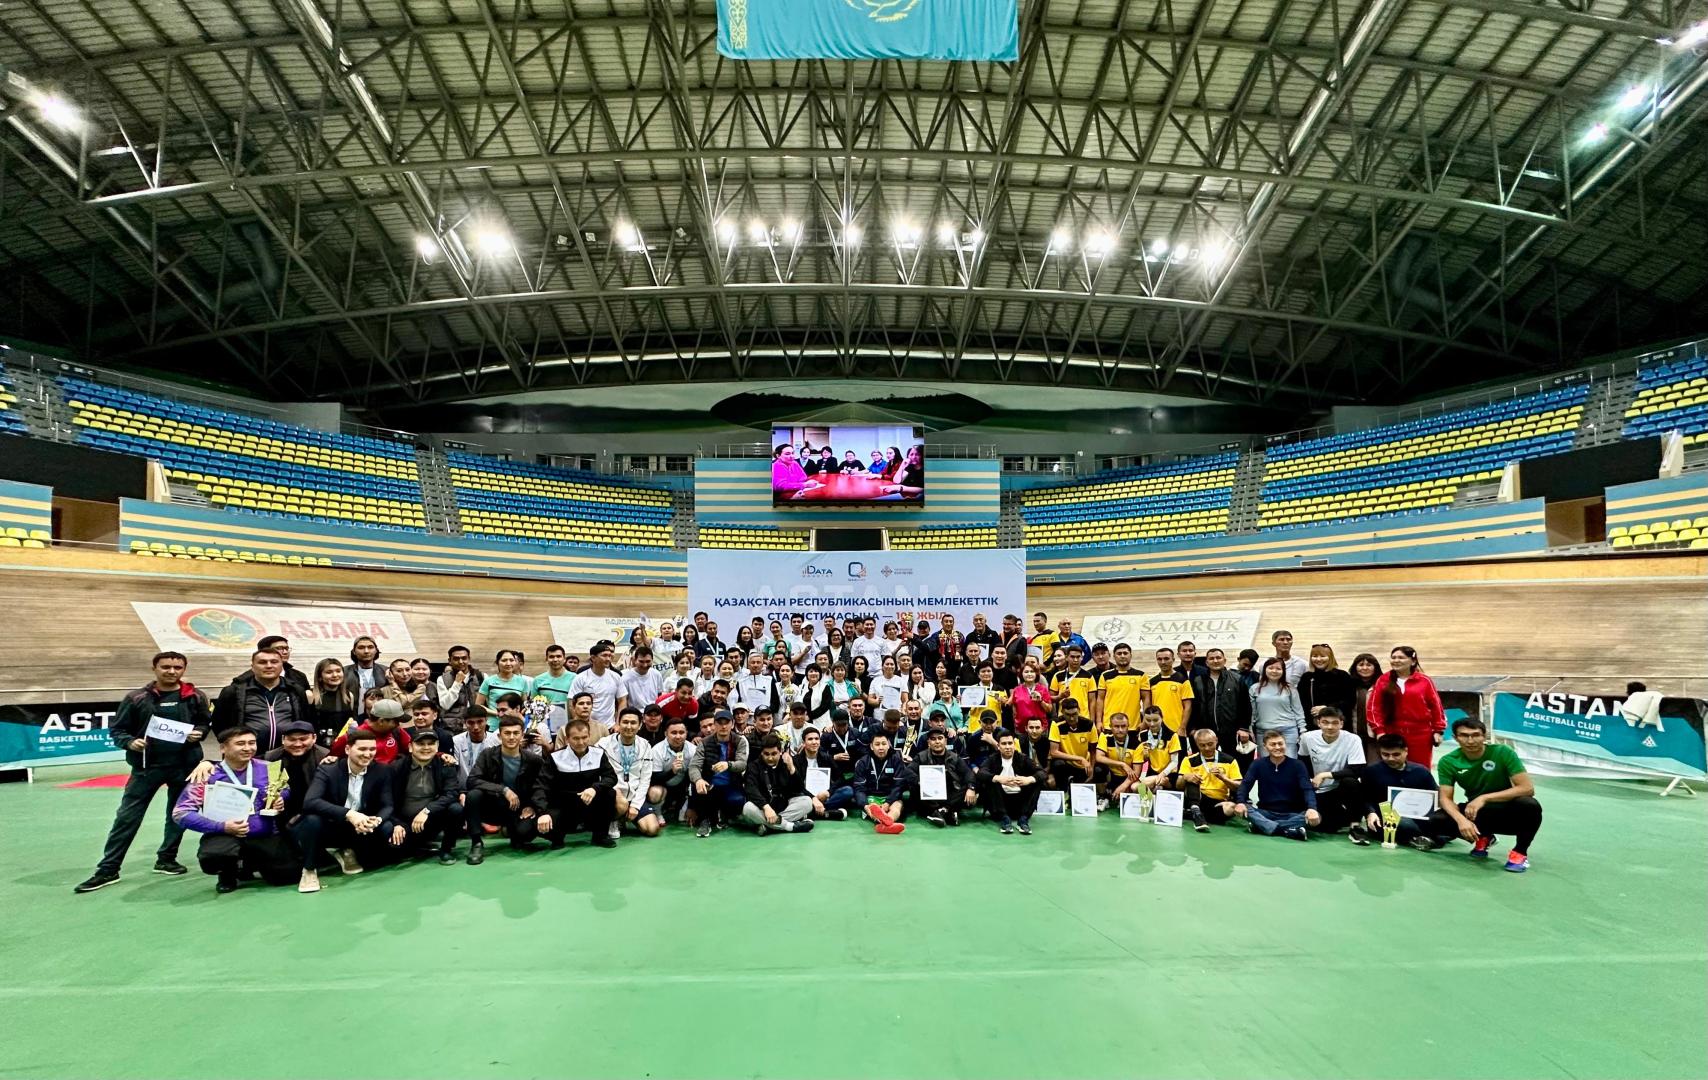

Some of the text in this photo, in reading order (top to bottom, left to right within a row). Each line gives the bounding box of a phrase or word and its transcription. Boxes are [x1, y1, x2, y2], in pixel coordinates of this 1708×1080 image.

[714, 597, 999, 608] ҚАЗАҚСТАН РЕСПУБЛИКАСЫНЫҢ МЕМЛЕКЕТТІК
[279, 620, 390, 640] ASTANA
[1141, 619, 1241, 633] SAMRUK
[1138, 633, 1237, 642] KAZYNA
[39, 711, 116, 735] AST
[1523, 711, 1576, 728] BASKETBALL
[1577, 721, 1602, 732] CLUB
[38, 734, 105, 744] BASKETBALL
